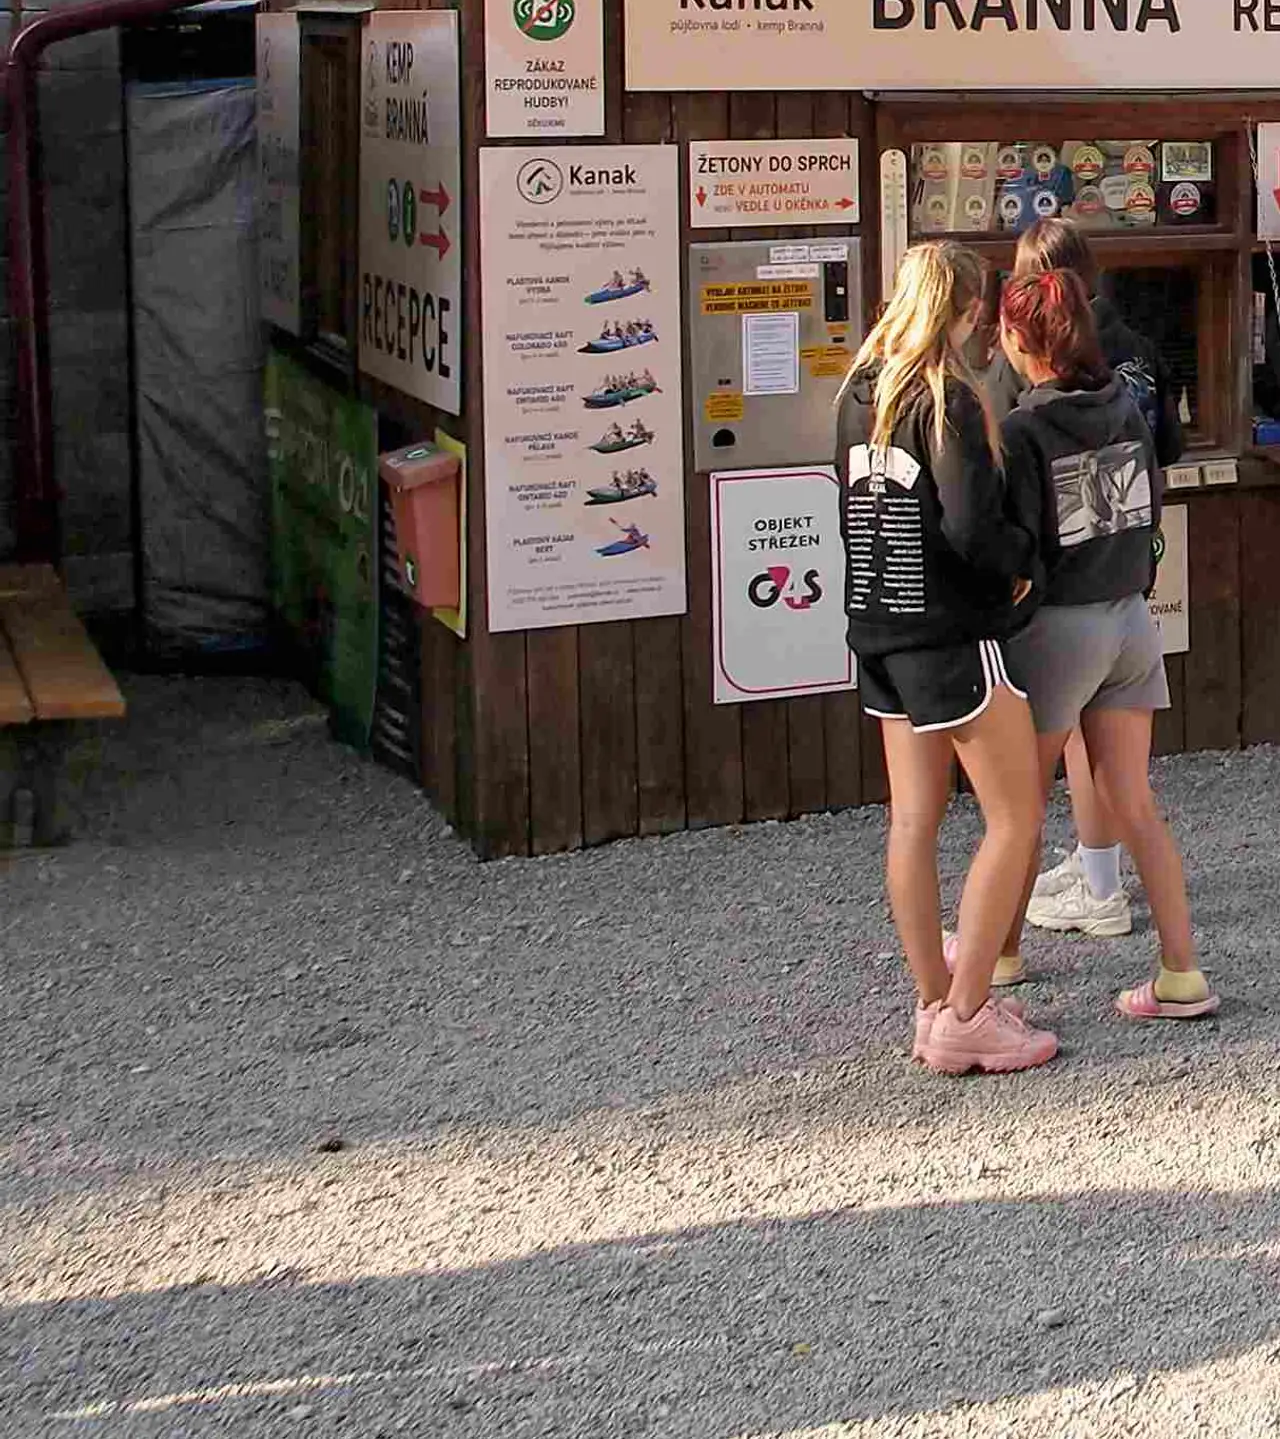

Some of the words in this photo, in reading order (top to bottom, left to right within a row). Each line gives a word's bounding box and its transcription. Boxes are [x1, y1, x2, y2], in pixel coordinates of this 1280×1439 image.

[757, 20, 785, 35] kemp
[386, 42, 414, 84] KEMP
[526, 59, 566, 73] ZÁKAZ
[494, 76, 598, 91] REPRODUKOVANÉ
[523, 96, 569, 109] HUDBY!
[386, 89, 429, 145] BRANNÁ
[698, 153, 763, 174] ŽETONY
[769, 155, 792, 172] DO
[797, 154, 851, 172] SPRCH
[569, 163, 637, 186] Kanak
[713, 184, 735, 197] ZDE
[738, 183, 746, 196] V
[749, 182, 810, 196] AUTOMATU
[735, 199, 771, 212] VEDLE
[774, 199, 782, 211] U
[363, 273, 452, 380] RECEPCE
[754, 516, 814, 533] OBJEKT
[747, 565, 823, 610] G4S
